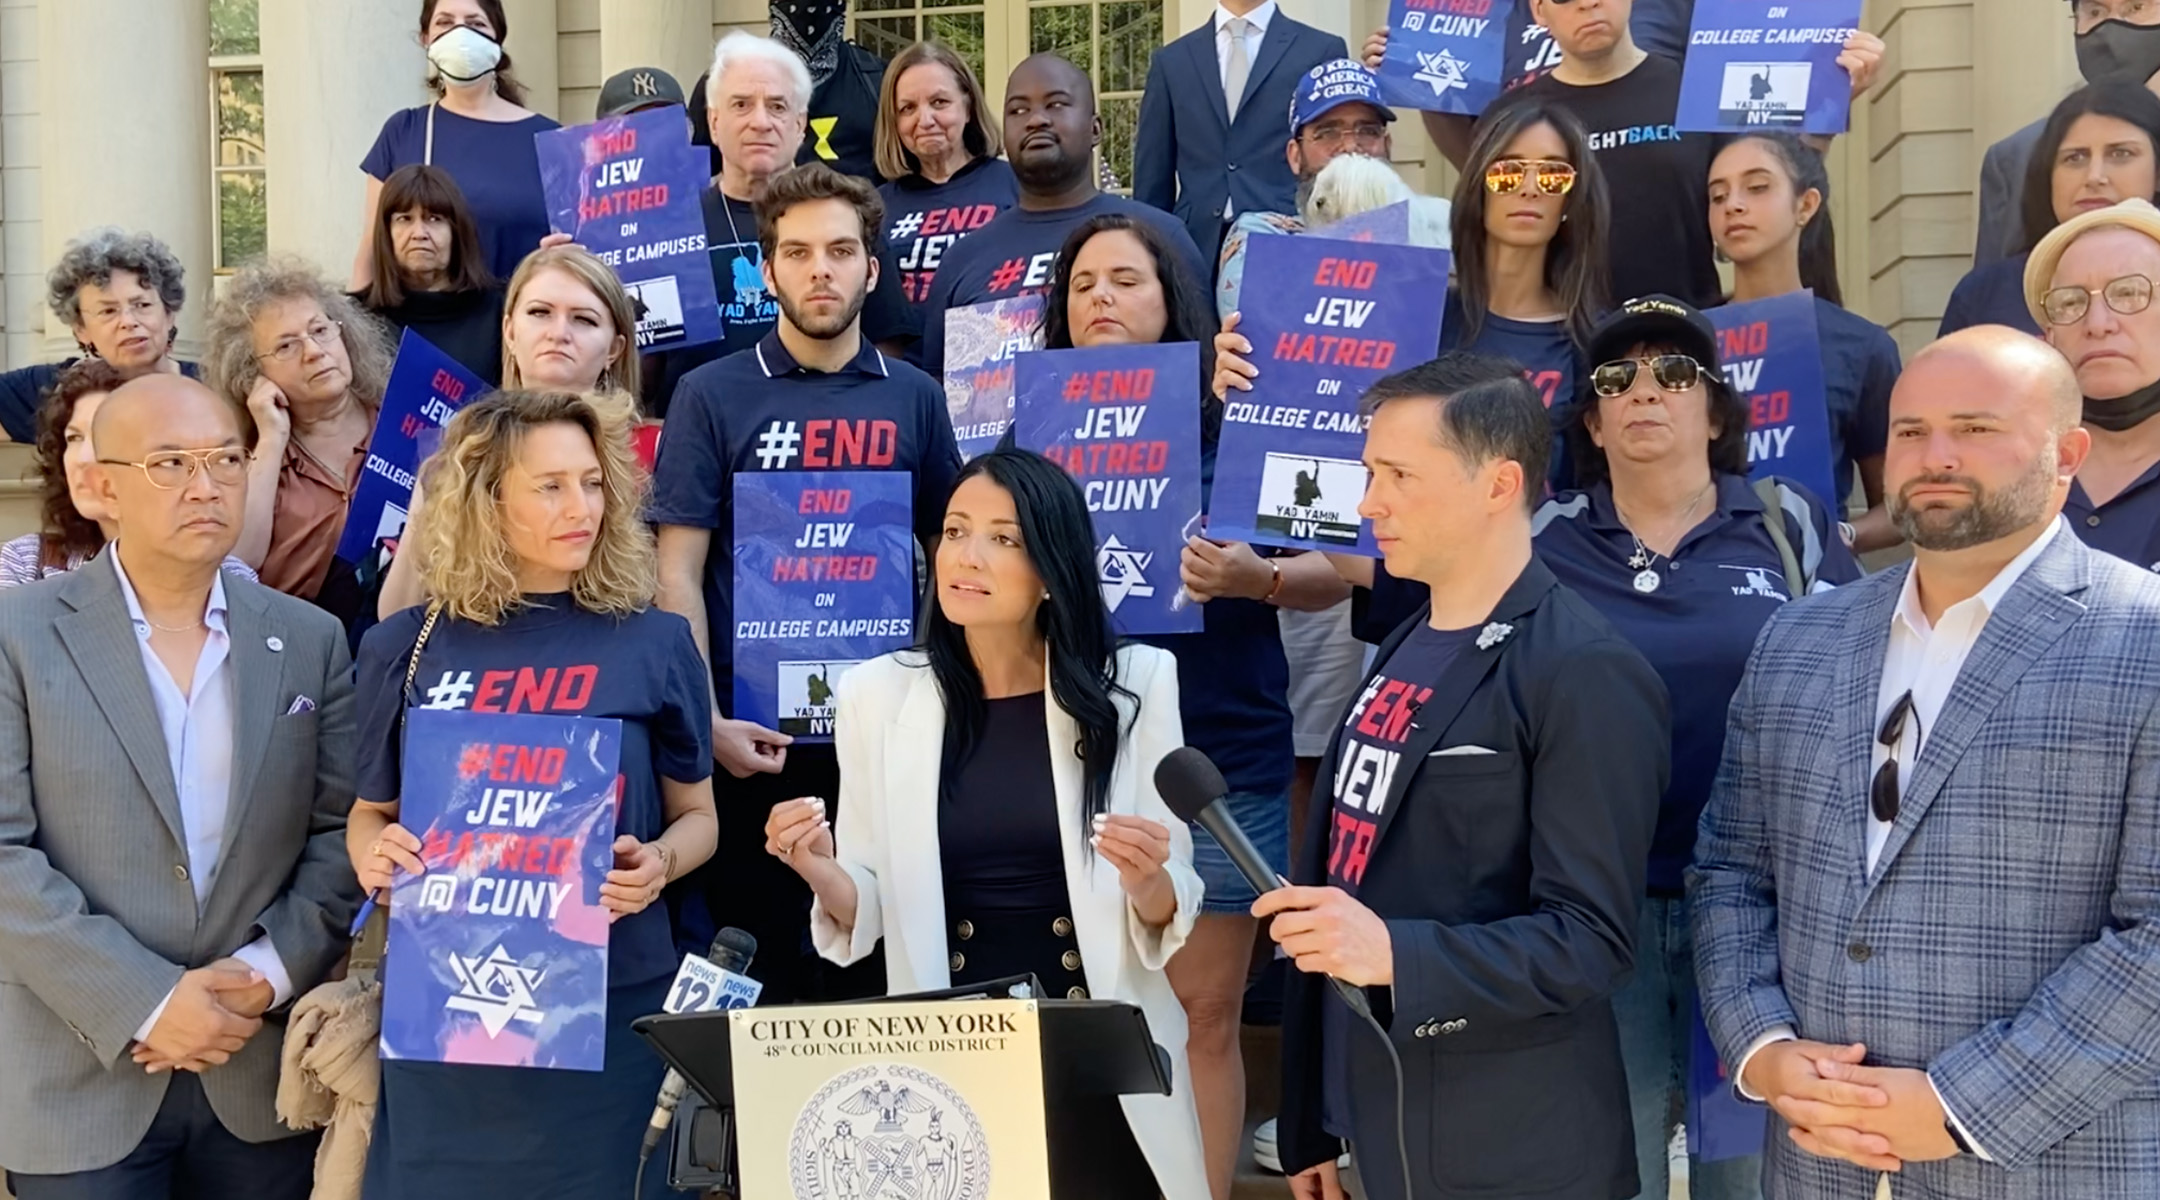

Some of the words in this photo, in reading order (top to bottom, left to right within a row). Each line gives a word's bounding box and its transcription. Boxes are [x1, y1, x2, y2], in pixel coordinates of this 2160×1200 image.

[1402, 11, 1426, 31] @
[1428, 14, 1490, 38] CUNY
[1767, 7, 1788, 19] ON
[1691, 29, 1763, 45] COLLEGE
[1764, 28, 1857, 44] CAMPUSES
[1326, 59, 1361, 74] KEEP
[1313, 70, 1377, 91] AMERICA
[1323, 83, 1370, 98] GREAT
[1747, 111, 1771, 124] NY
[596, 158, 644, 188] JEW
[579, 184, 669, 222] HATRED
[621, 222, 638, 237] ON
[890, 204, 997, 239] #END
[625, 234, 706, 263] CAMPUSES
[988, 252, 1061, 293] #E
[1314, 258, 1378, 290] END
[717, 303, 745, 317] YAD
[1304, 297, 1376, 329] JEW
[635, 329, 655, 347] NY
[1273, 332, 1397, 370] HATRED
[431, 367, 466, 402] END
[1062, 368, 1156, 404] #END
[1316, 379, 1341, 395] ON
[1074, 405, 1147, 440] JEW
[1224, 402, 1311, 428] COLLEGE
[756, 419, 898, 469] #END
[953, 420, 1006, 442] OLLEGE
[1744, 425, 1795, 462] NY
[366, 454, 416, 490] COLLEGE
[798, 489, 851, 514] END
[1084, 478, 1170, 512] CUNY
[1276, 505, 1298, 518] YAD
[1304, 508, 1340, 522] YAMIN
[795, 523, 855, 548] JEW
[1290, 520, 1319, 539] NY
[772, 556, 878, 582] HATRED
[815, 593, 836, 607] ON
[1731, 586, 1753, 596] YAD
[736, 620, 812, 639] COLLEGE
[815, 619, 911, 638] CAMPUSES
[420, 665, 599, 714] #END
[794, 708, 814, 717] YAD
[810, 719, 834, 734] NY
[458, 742, 567, 786] #END
[466, 788, 554, 828] JEW
[419, 828, 575, 875] HATRED
[418, 874, 458, 912] @
[467, 877, 573, 919] CUNY
[684, 960, 718, 984] news
[673, 976, 710, 1013] 12
[723, 979, 756, 999] news
[751, 1019, 816, 1042] CITY
[823, 1017, 859, 1039] OF
[866, 1015, 929, 1038] NEW
[936, 1012, 1018, 1035] YORK
[763, 1044, 787, 1058] 48th
[791, 1039, 924, 1057] COUNCILMANIC
[928, 1037, 1008, 1054] DISTRICT
